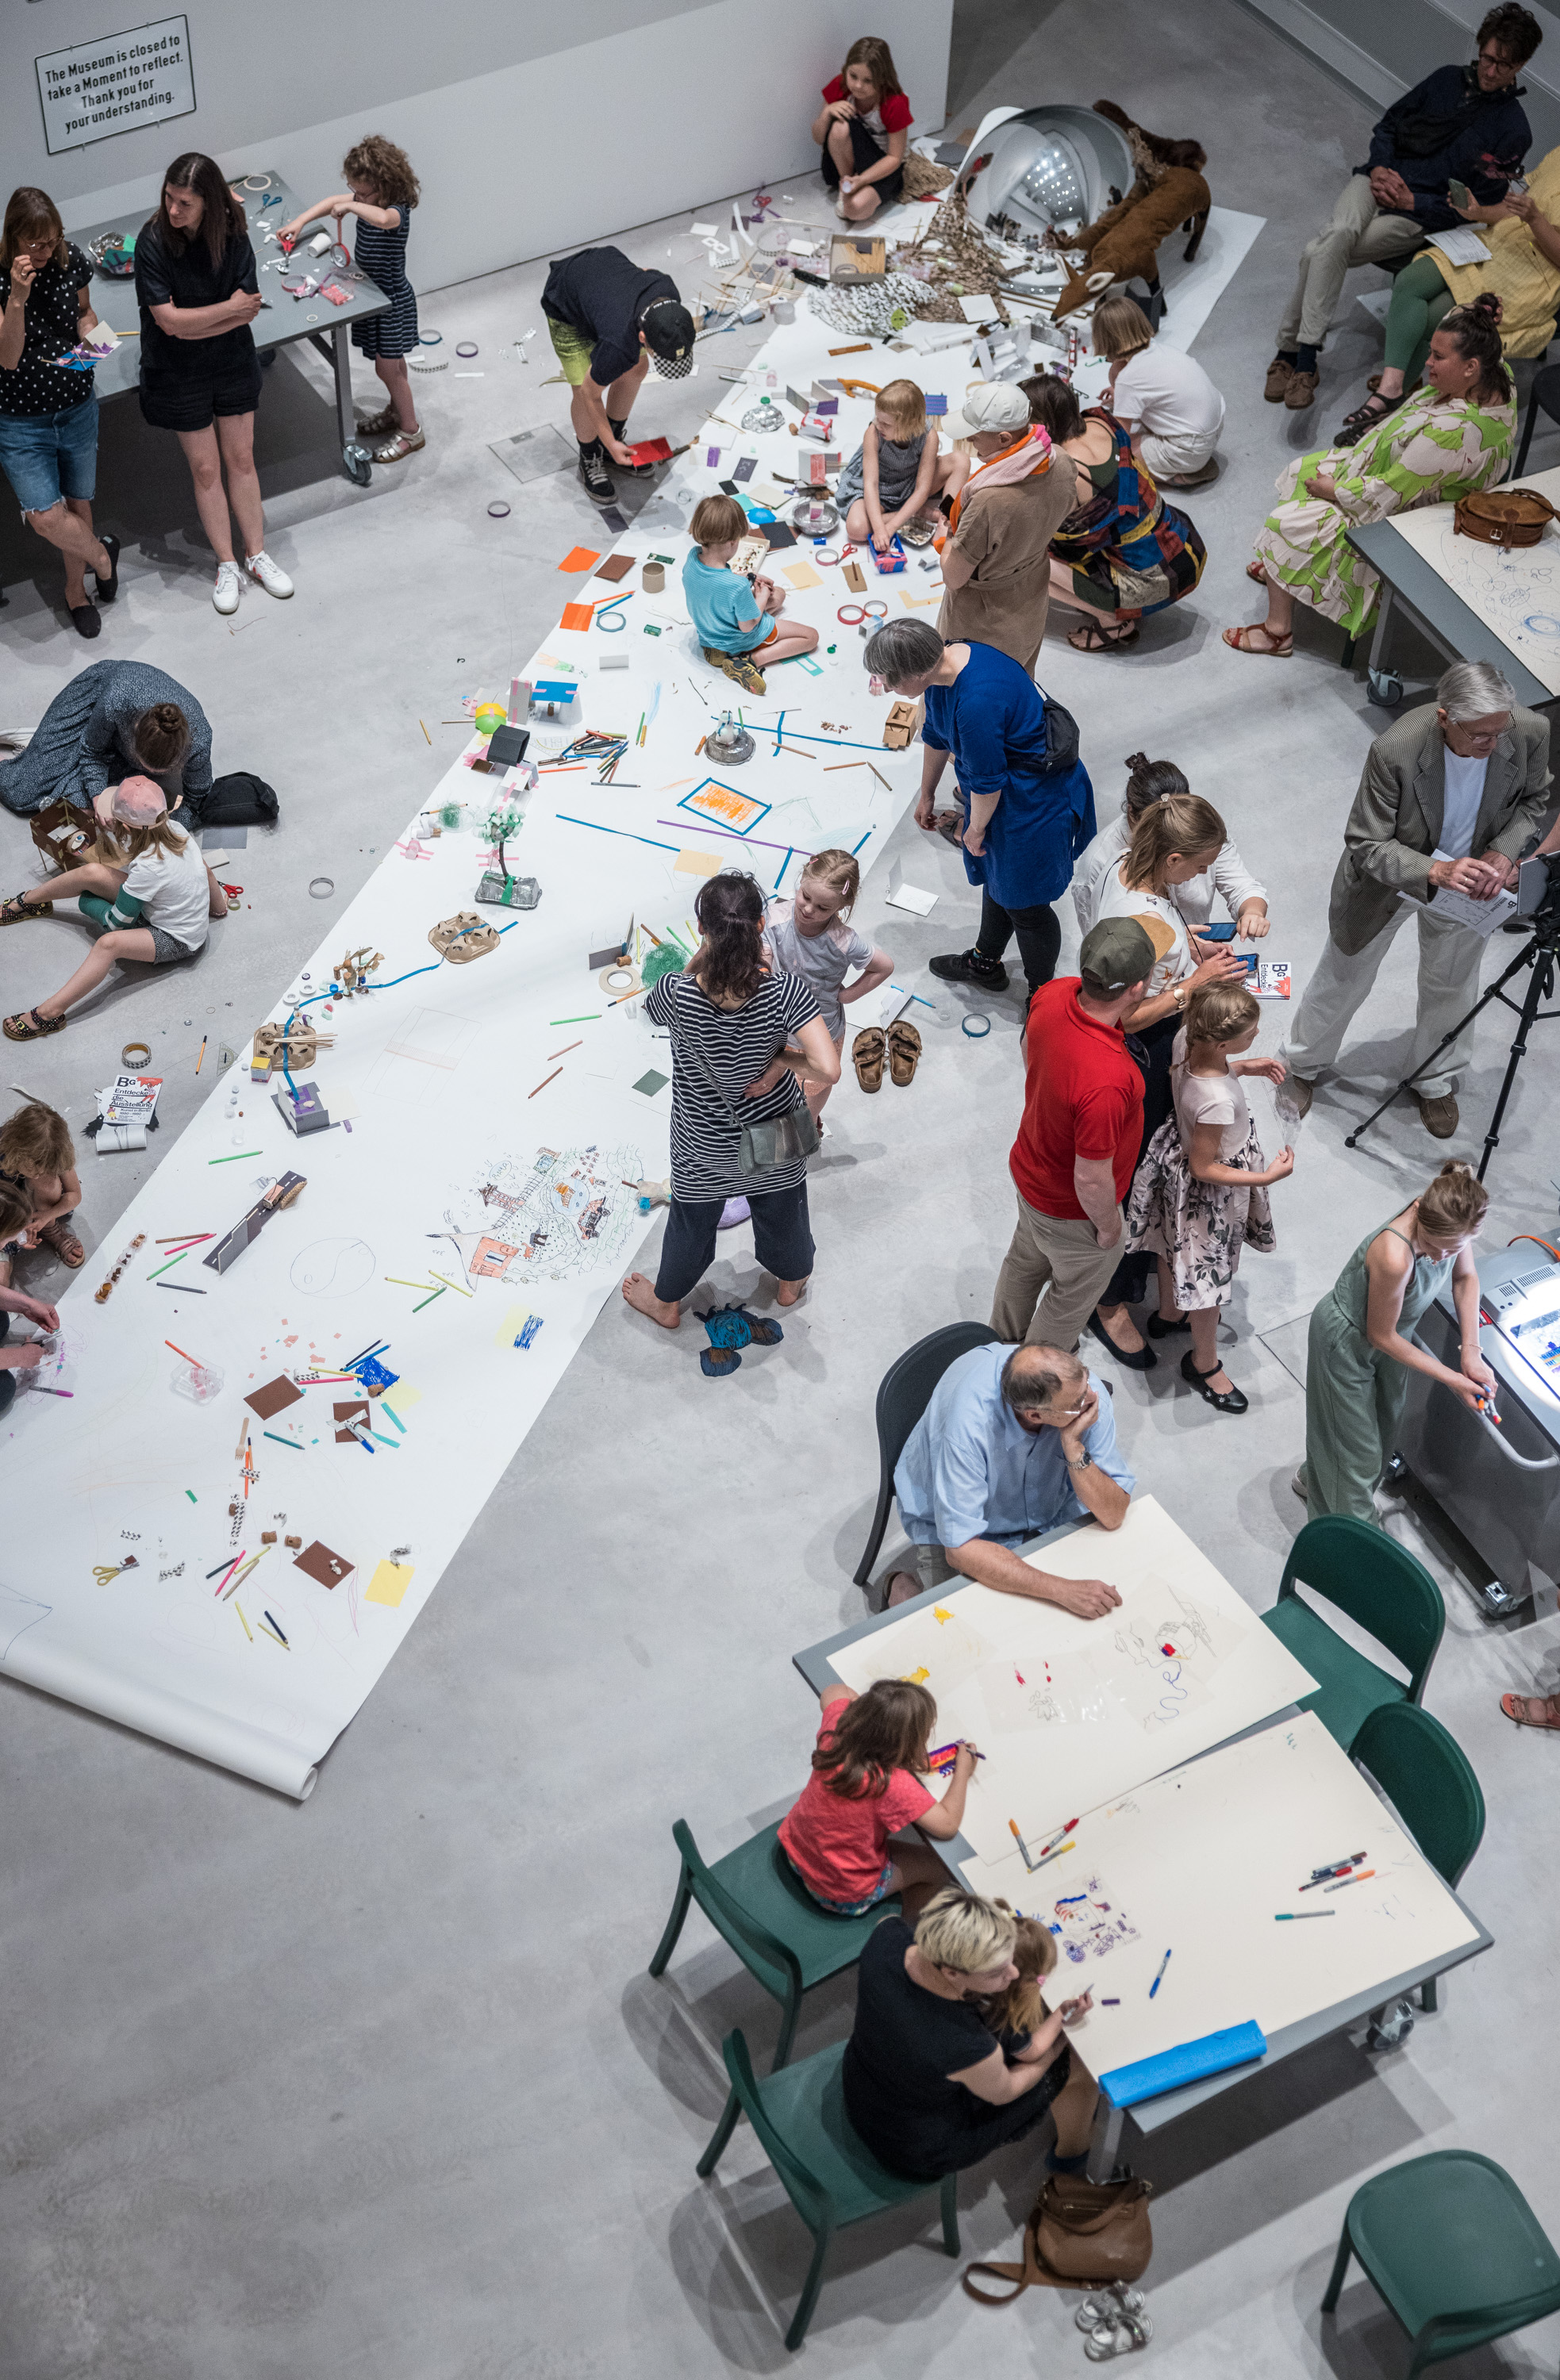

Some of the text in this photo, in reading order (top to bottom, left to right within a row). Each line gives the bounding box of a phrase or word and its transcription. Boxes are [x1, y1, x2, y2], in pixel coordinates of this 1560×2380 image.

[45, 36, 180, 83] The Museum is closed to
[48, 52, 183, 102] take a Moment to reflect.
[81, 79, 154, 108] Thank you for
[65, 91, 175, 135] your understanding.
[1272, 964, 1288, 977] BG
[117, 1077, 136, 1087] BG
